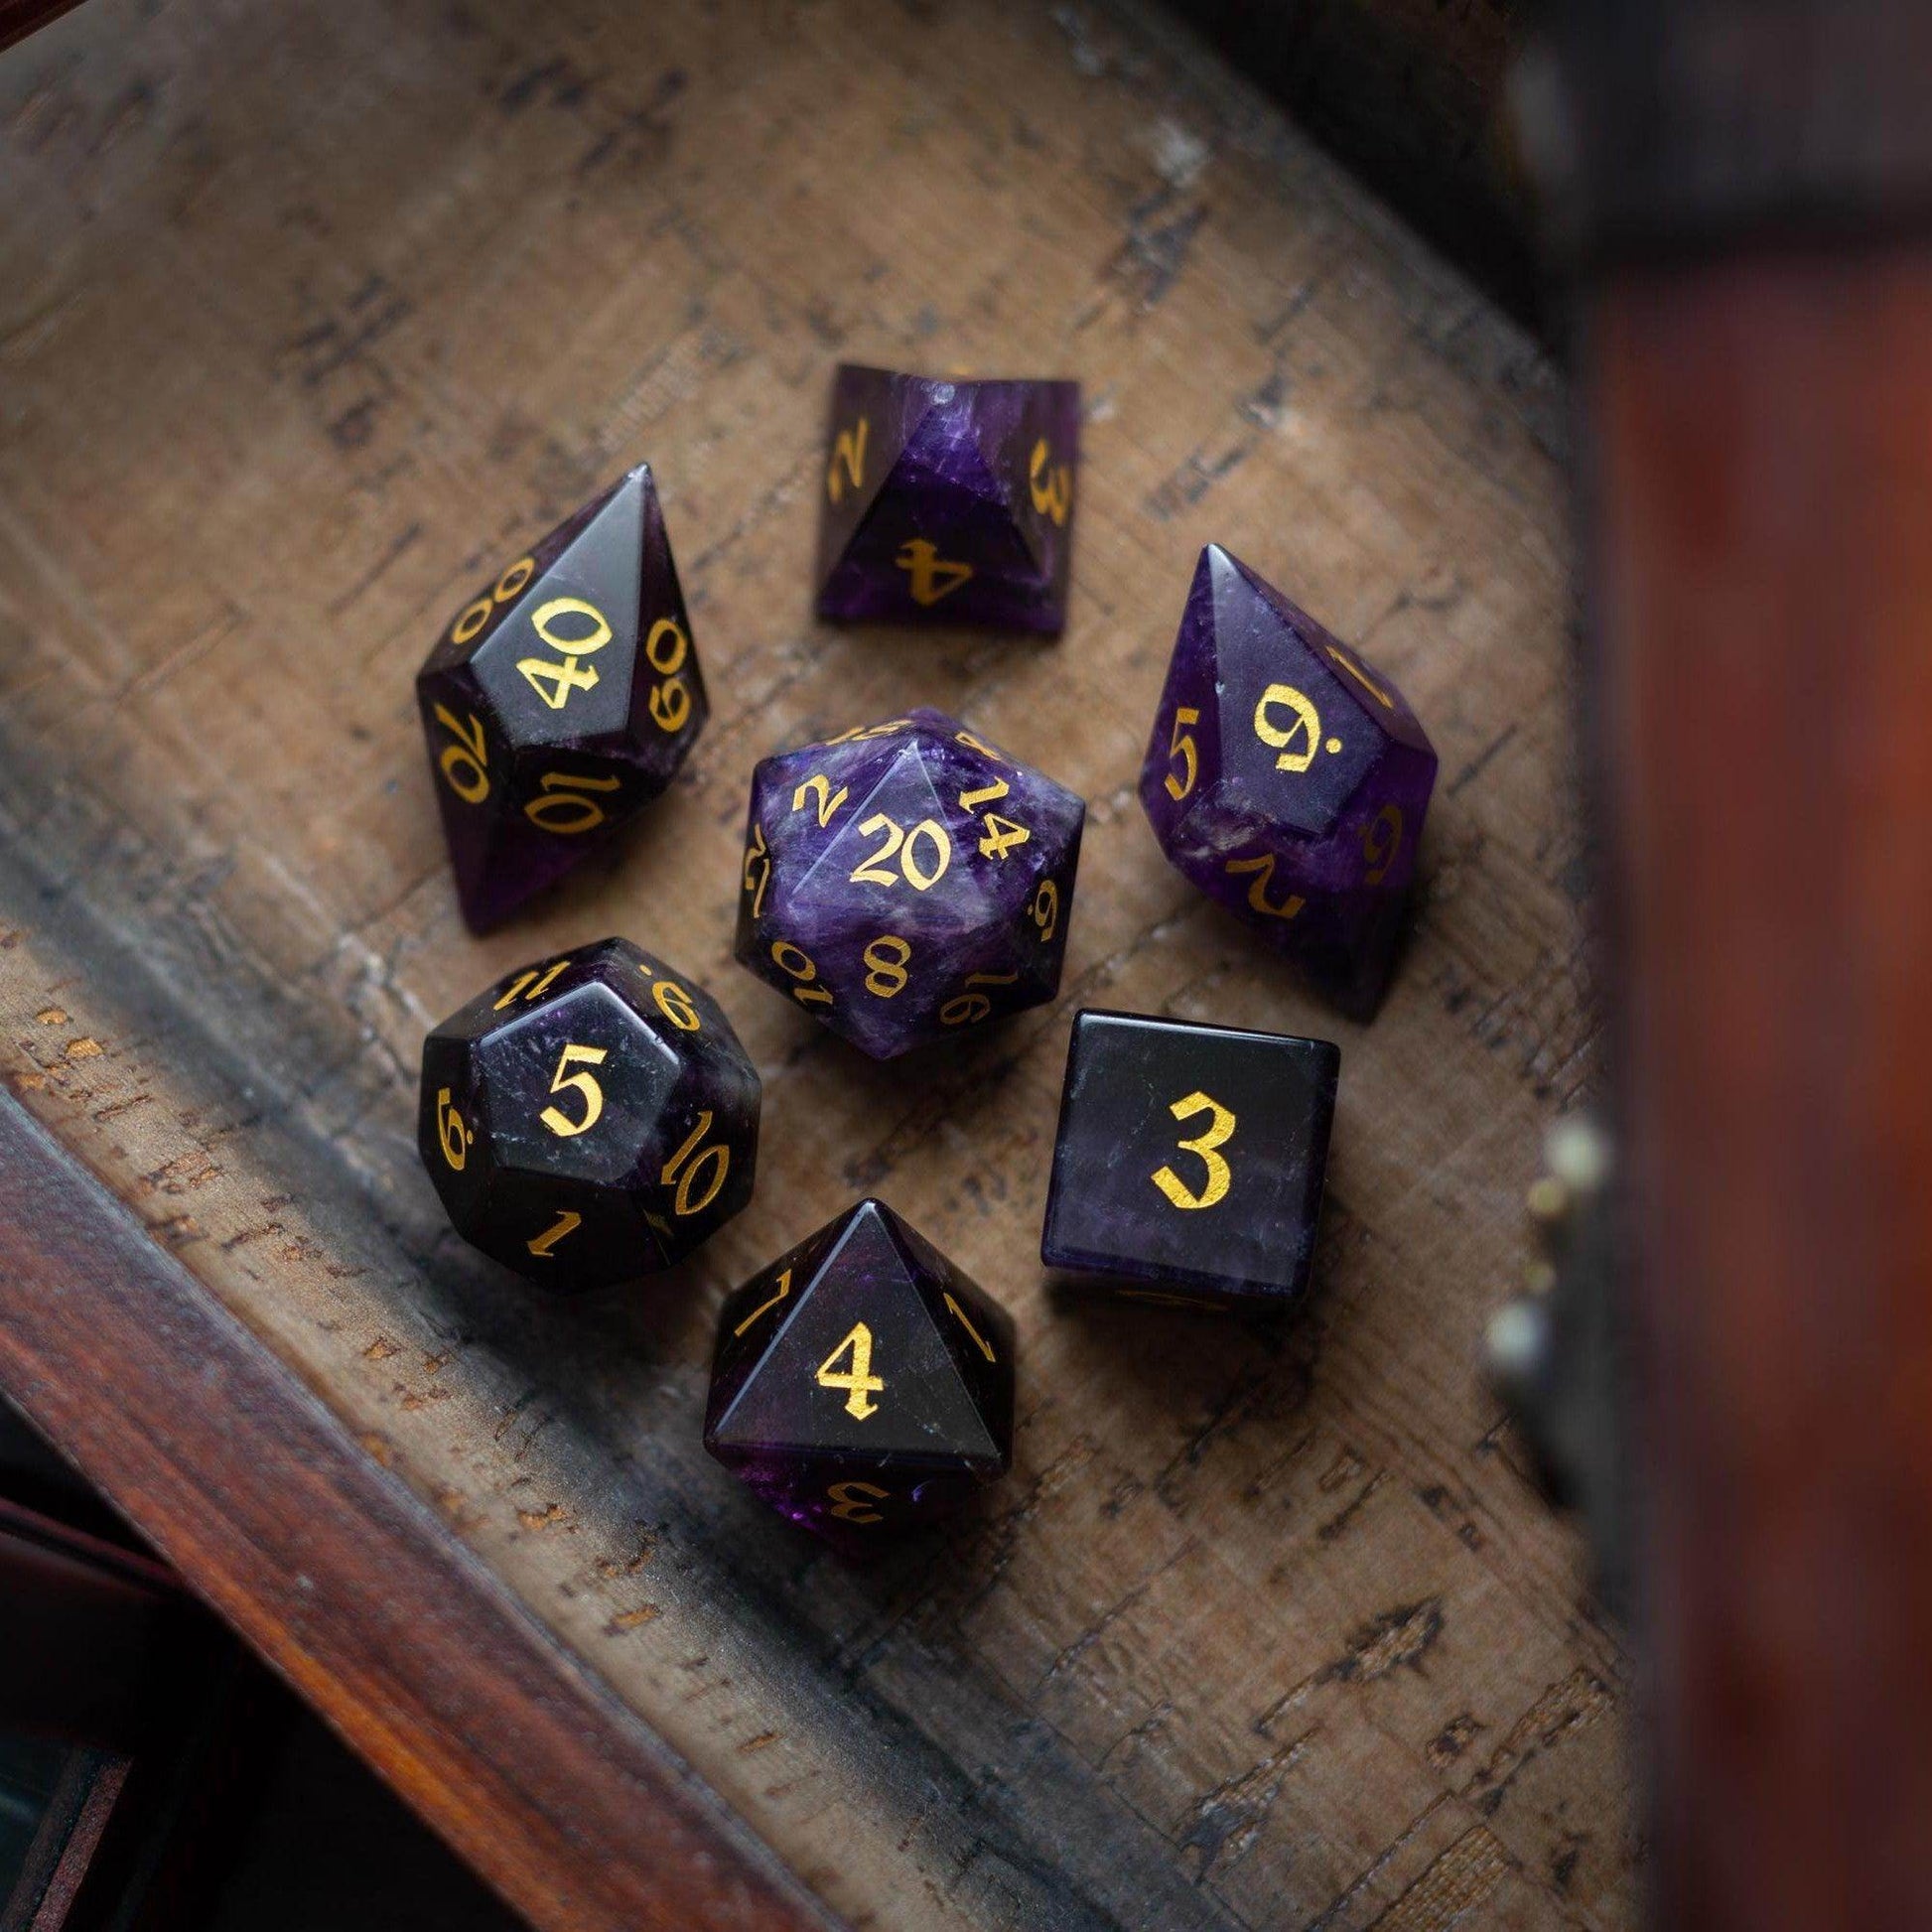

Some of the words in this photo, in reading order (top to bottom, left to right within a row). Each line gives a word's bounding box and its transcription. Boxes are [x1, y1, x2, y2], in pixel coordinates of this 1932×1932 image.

[1029, 438, 1071, 527] 3
[451, 556, 536, 644] 00
[896, 537, 973, 607] 4
[515, 597, 614, 709] 40
[434, 702, 490, 804] 70
[1164, 708, 1200, 801] 5
[523, 771, 621, 834] 10
[791, 773, 849, 829] 2
[958, 775, 1032, 861] 14
[849, 812, 951, 892] 20
[770, 940, 834, 1006] 10
[863, 935, 912, 999] 8
[539, 1043, 609, 1138] 5
[660, 1110, 731, 1216] 10
[1150, 1090, 1237, 1210] 3
[525, 1210, 583, 1258] 1
[815, 1321, 886, 1422] 4
[826, 1481, 893, 1525] 3
